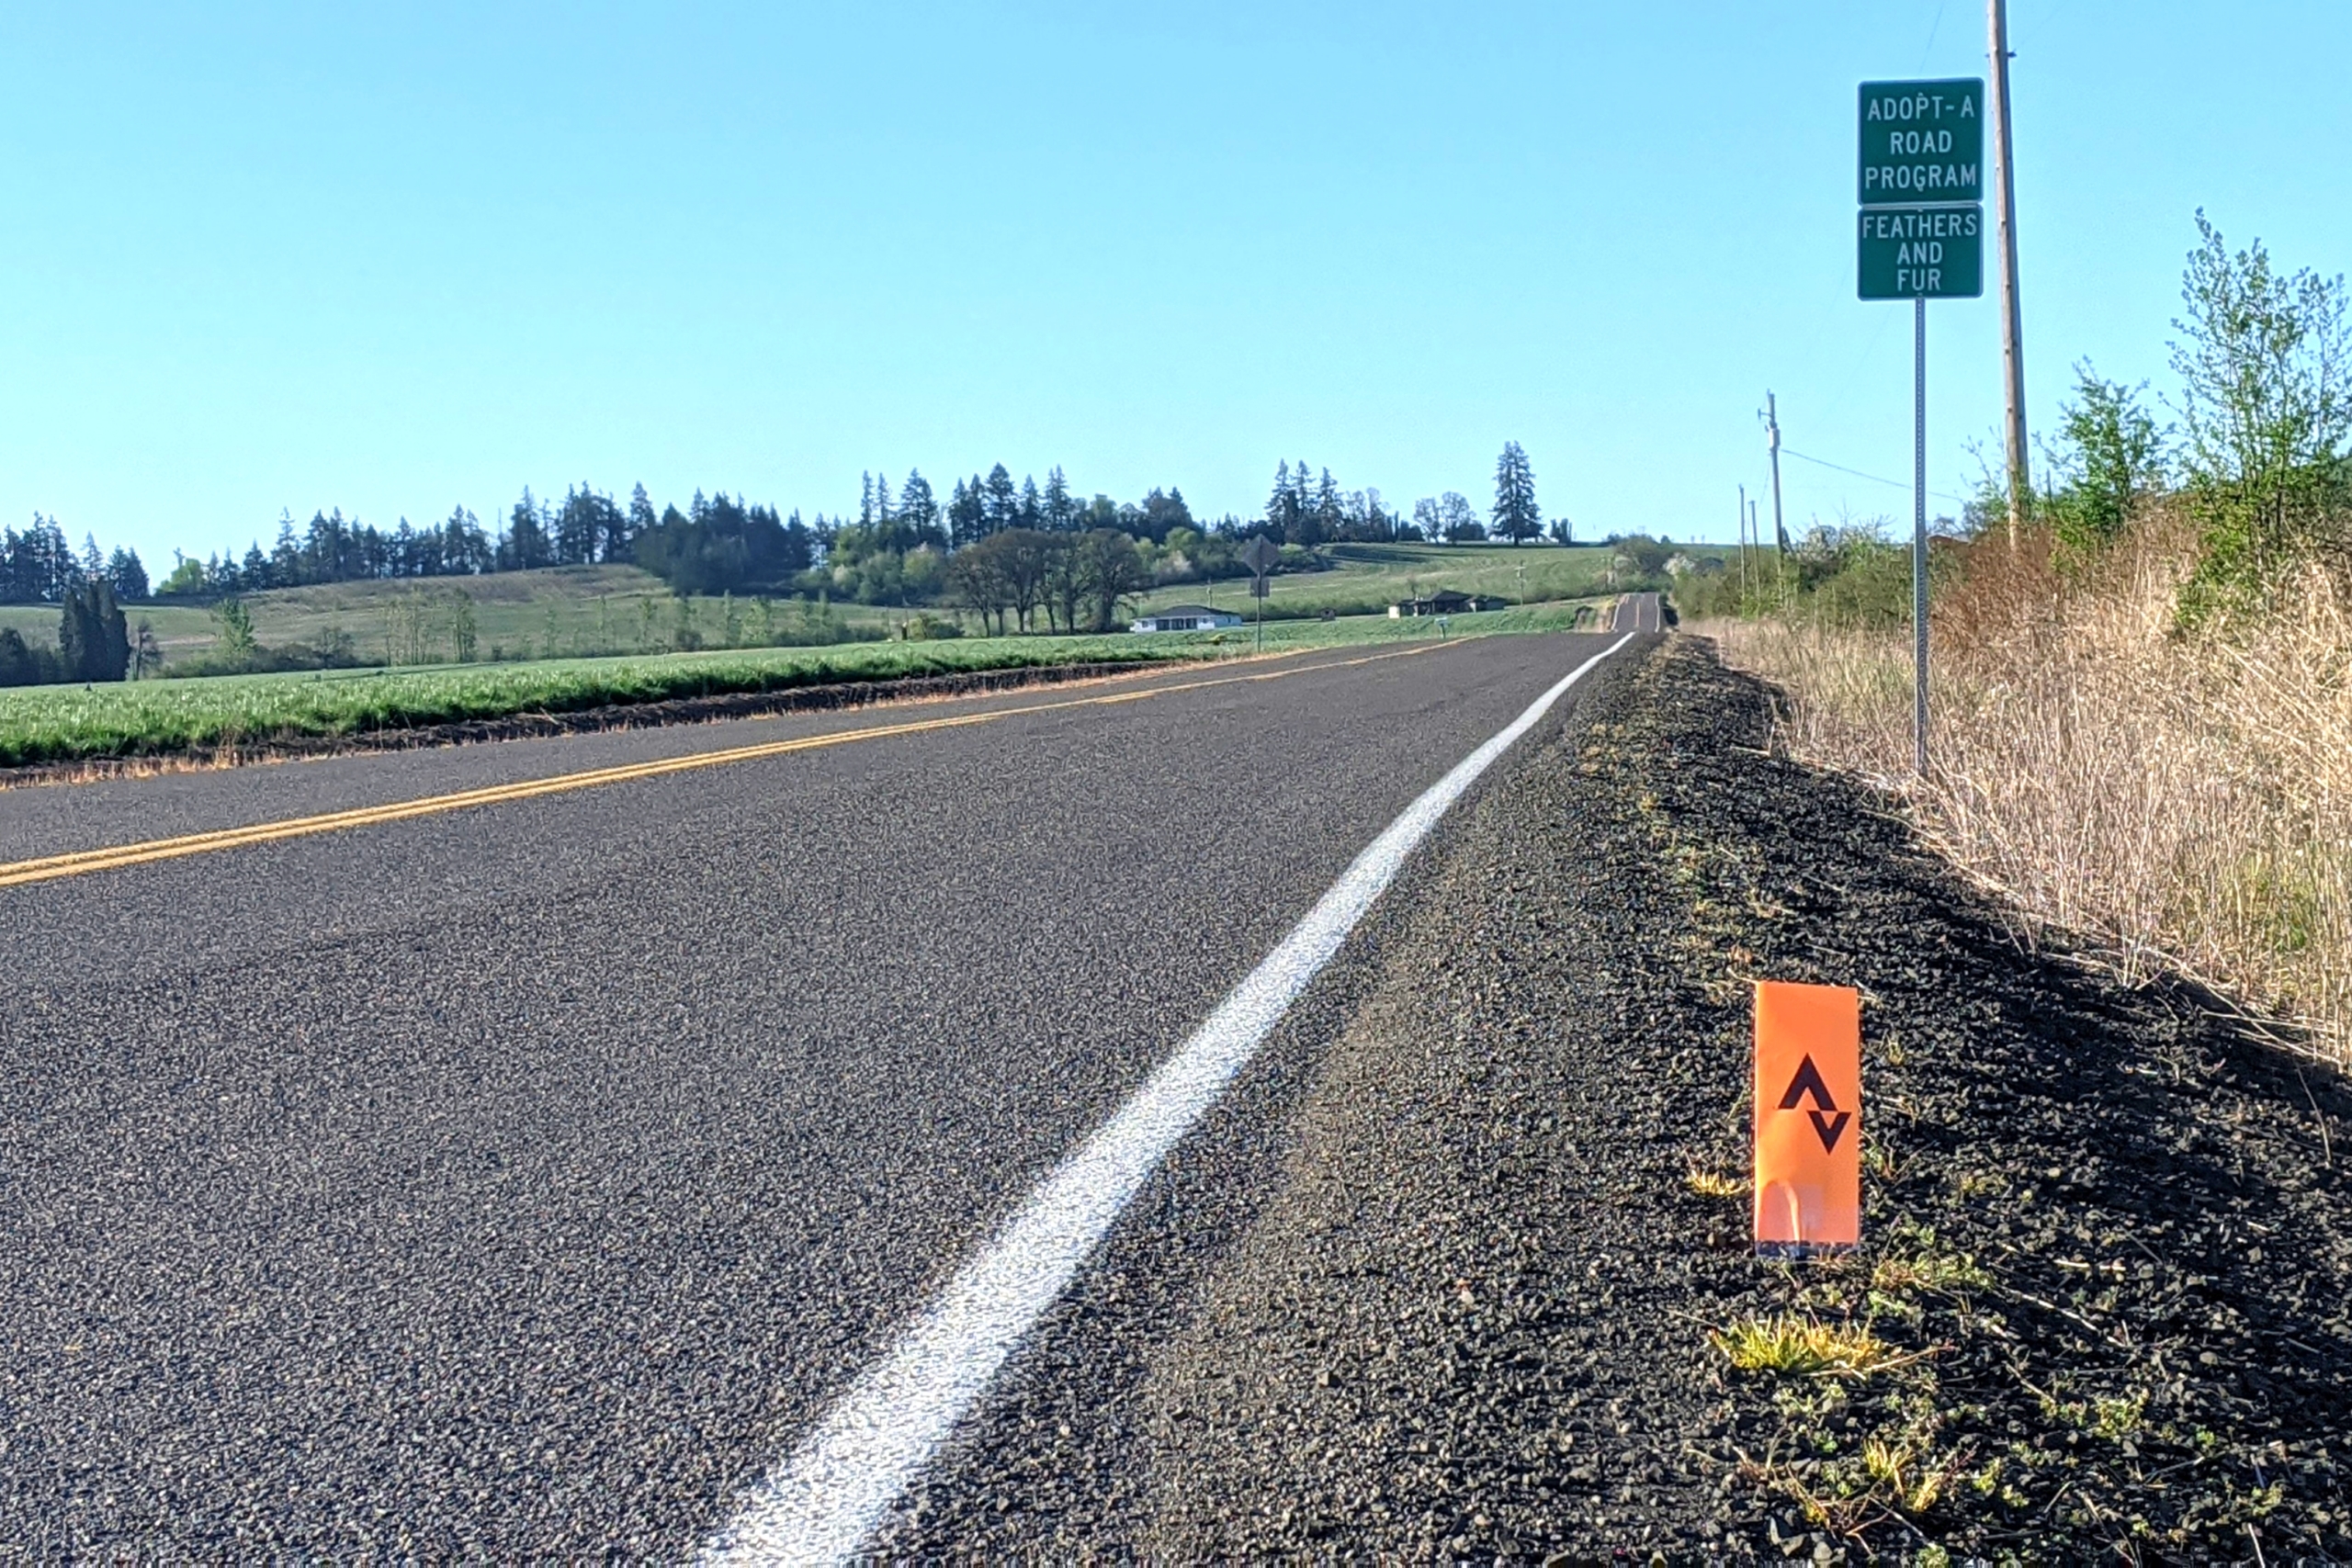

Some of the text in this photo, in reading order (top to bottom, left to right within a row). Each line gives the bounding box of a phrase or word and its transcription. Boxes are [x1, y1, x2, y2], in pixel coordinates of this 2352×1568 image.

[1890, 130, 1952, 155] ROAD
[1865, 164, 1976, 189] PROGRAM
[1862, 213, 1977, 239] FEATHERS
[1896, 242, 1943, 265] AND
[1897, 269, 1941, 291] FUR
